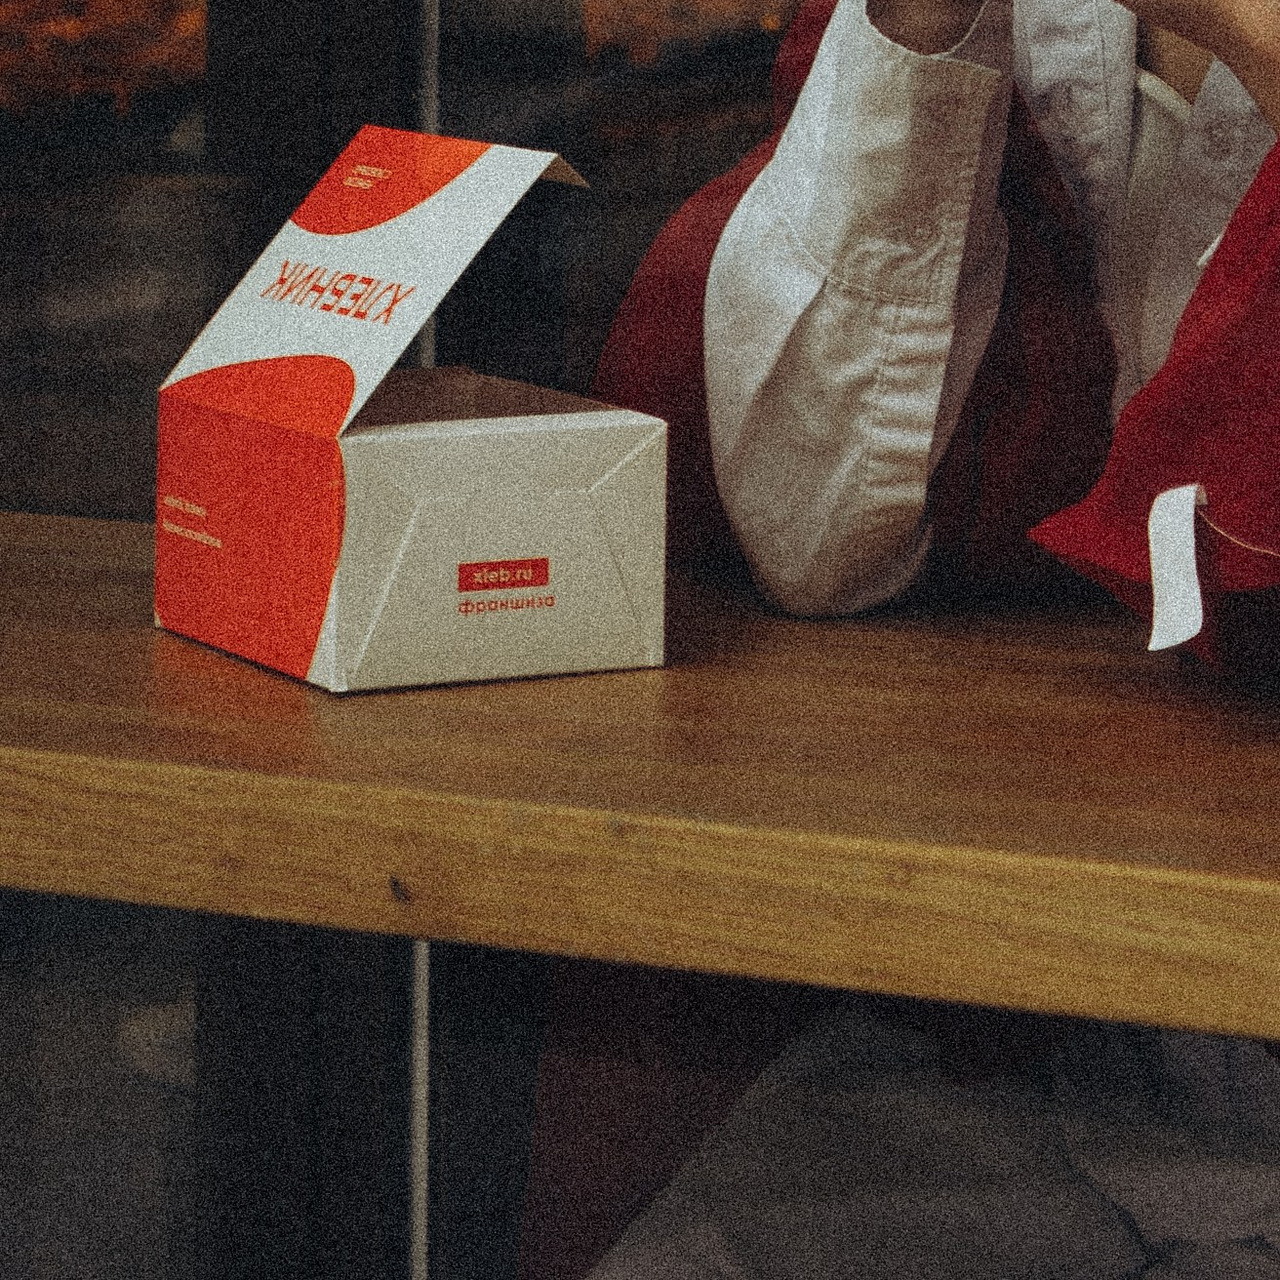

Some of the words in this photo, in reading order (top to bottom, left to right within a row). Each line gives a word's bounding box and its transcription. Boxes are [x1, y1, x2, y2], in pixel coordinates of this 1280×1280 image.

[260, 259, 416, 325] ХЛЕБНИК
[473, 567, 532, 585] xleb.ru
[458, 595, 556, 617] франшиза
